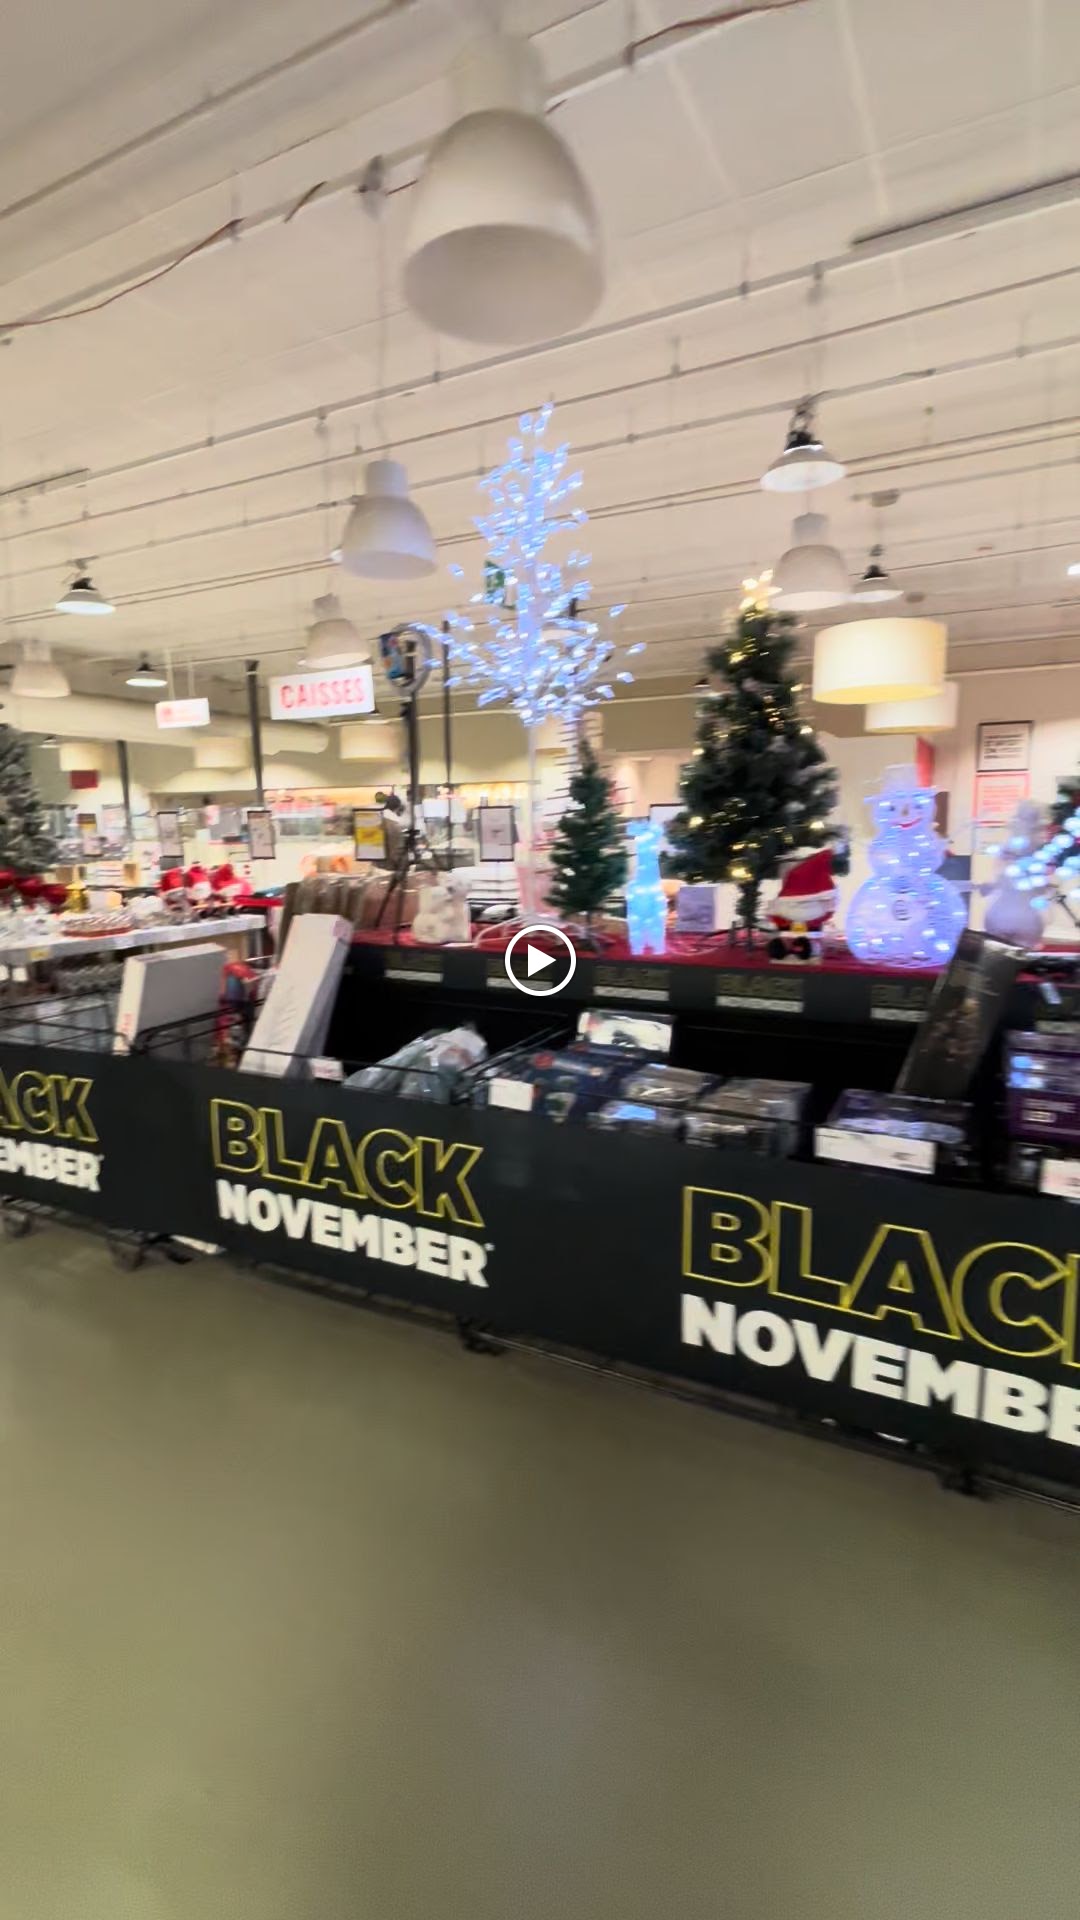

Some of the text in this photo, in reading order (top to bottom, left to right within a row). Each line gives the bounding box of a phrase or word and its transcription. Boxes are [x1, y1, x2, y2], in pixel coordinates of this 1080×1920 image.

[279, 677, 366, 709] CAISSES
[210, 1099, 485, 1228] BLACK
[215, 1178, 490, 1288] NOVEMBER
